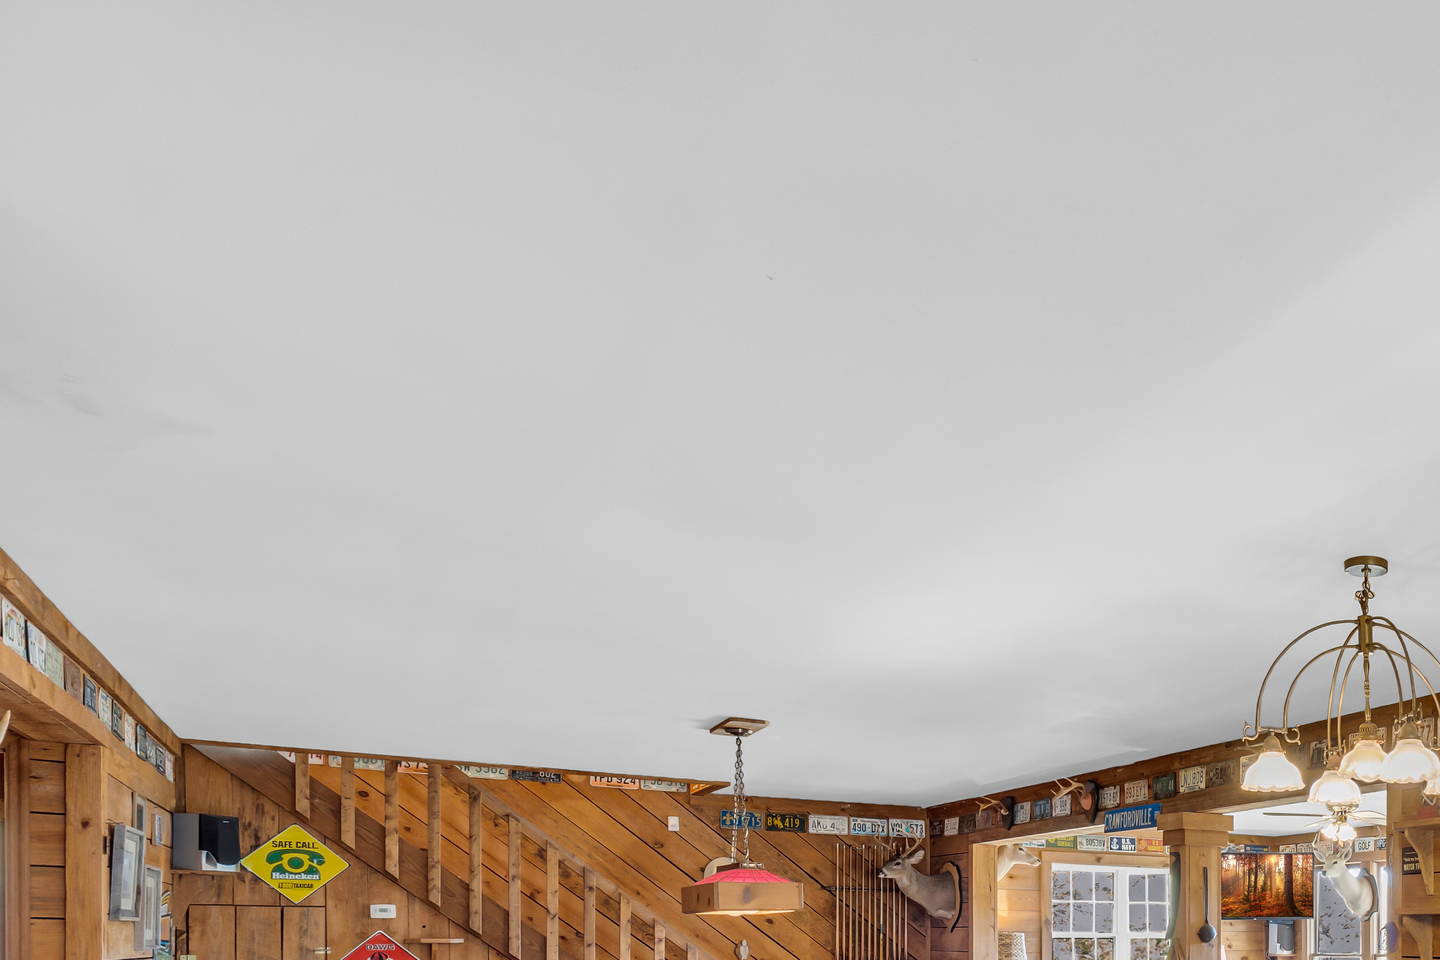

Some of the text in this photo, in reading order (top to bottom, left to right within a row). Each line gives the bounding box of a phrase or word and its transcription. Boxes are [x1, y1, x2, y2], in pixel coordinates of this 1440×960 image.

[784, 817, 800, 828] 419
[1105, 808, 1152, 831] CRAWFORDVILLE
[272, 840, 316, 849] SAFE CALL
[1358, 841, 1371, 851] GOLF
[272, 872, 319, 880] Heineken
[366, 943, 395, 951] DAWG
